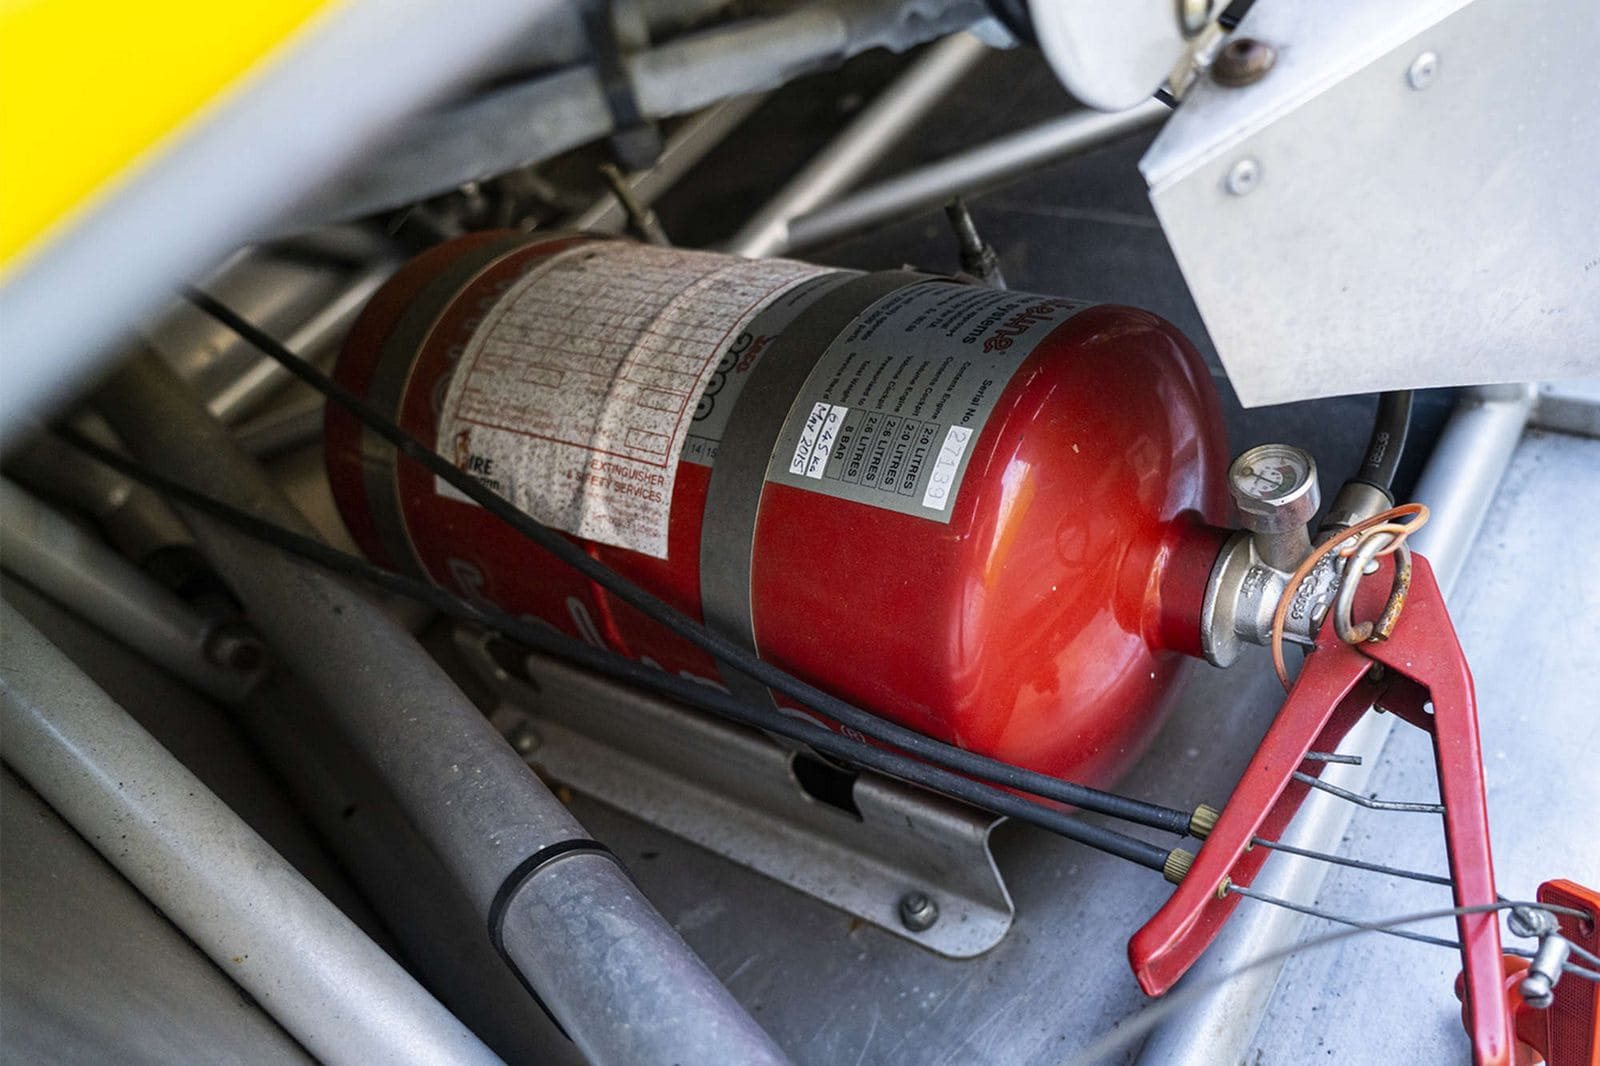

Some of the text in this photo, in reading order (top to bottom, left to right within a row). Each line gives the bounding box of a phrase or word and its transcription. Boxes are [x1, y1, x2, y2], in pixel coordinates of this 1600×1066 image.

[837, 352, 857, 378] Service
[875, 355, 914, 410] Volume Cockpit
[842, 375, 861, 403] Weight
[894, 360, 930, 413] Volume Engine
[913, 355, 954, 417] Contents Cockpit
[931, 360, 971, 420] Contents Engine
[960, 379, 993, 425] Serial No.
[691, 443, 700, 454] 14
[793, 436, 813, 473] 2015
[834, 425, 854, 460] 8 BAR
[847, 437, 867, 477] LITRES
[865, 440, 887, 481] LITRES
[590, 458, 665, 486] EXTINGUISHER
[884, 444, 906, 486] LITRES
[903, 446, 925, 489] LITRES
[613, 477, 663, 503] SERVICES
